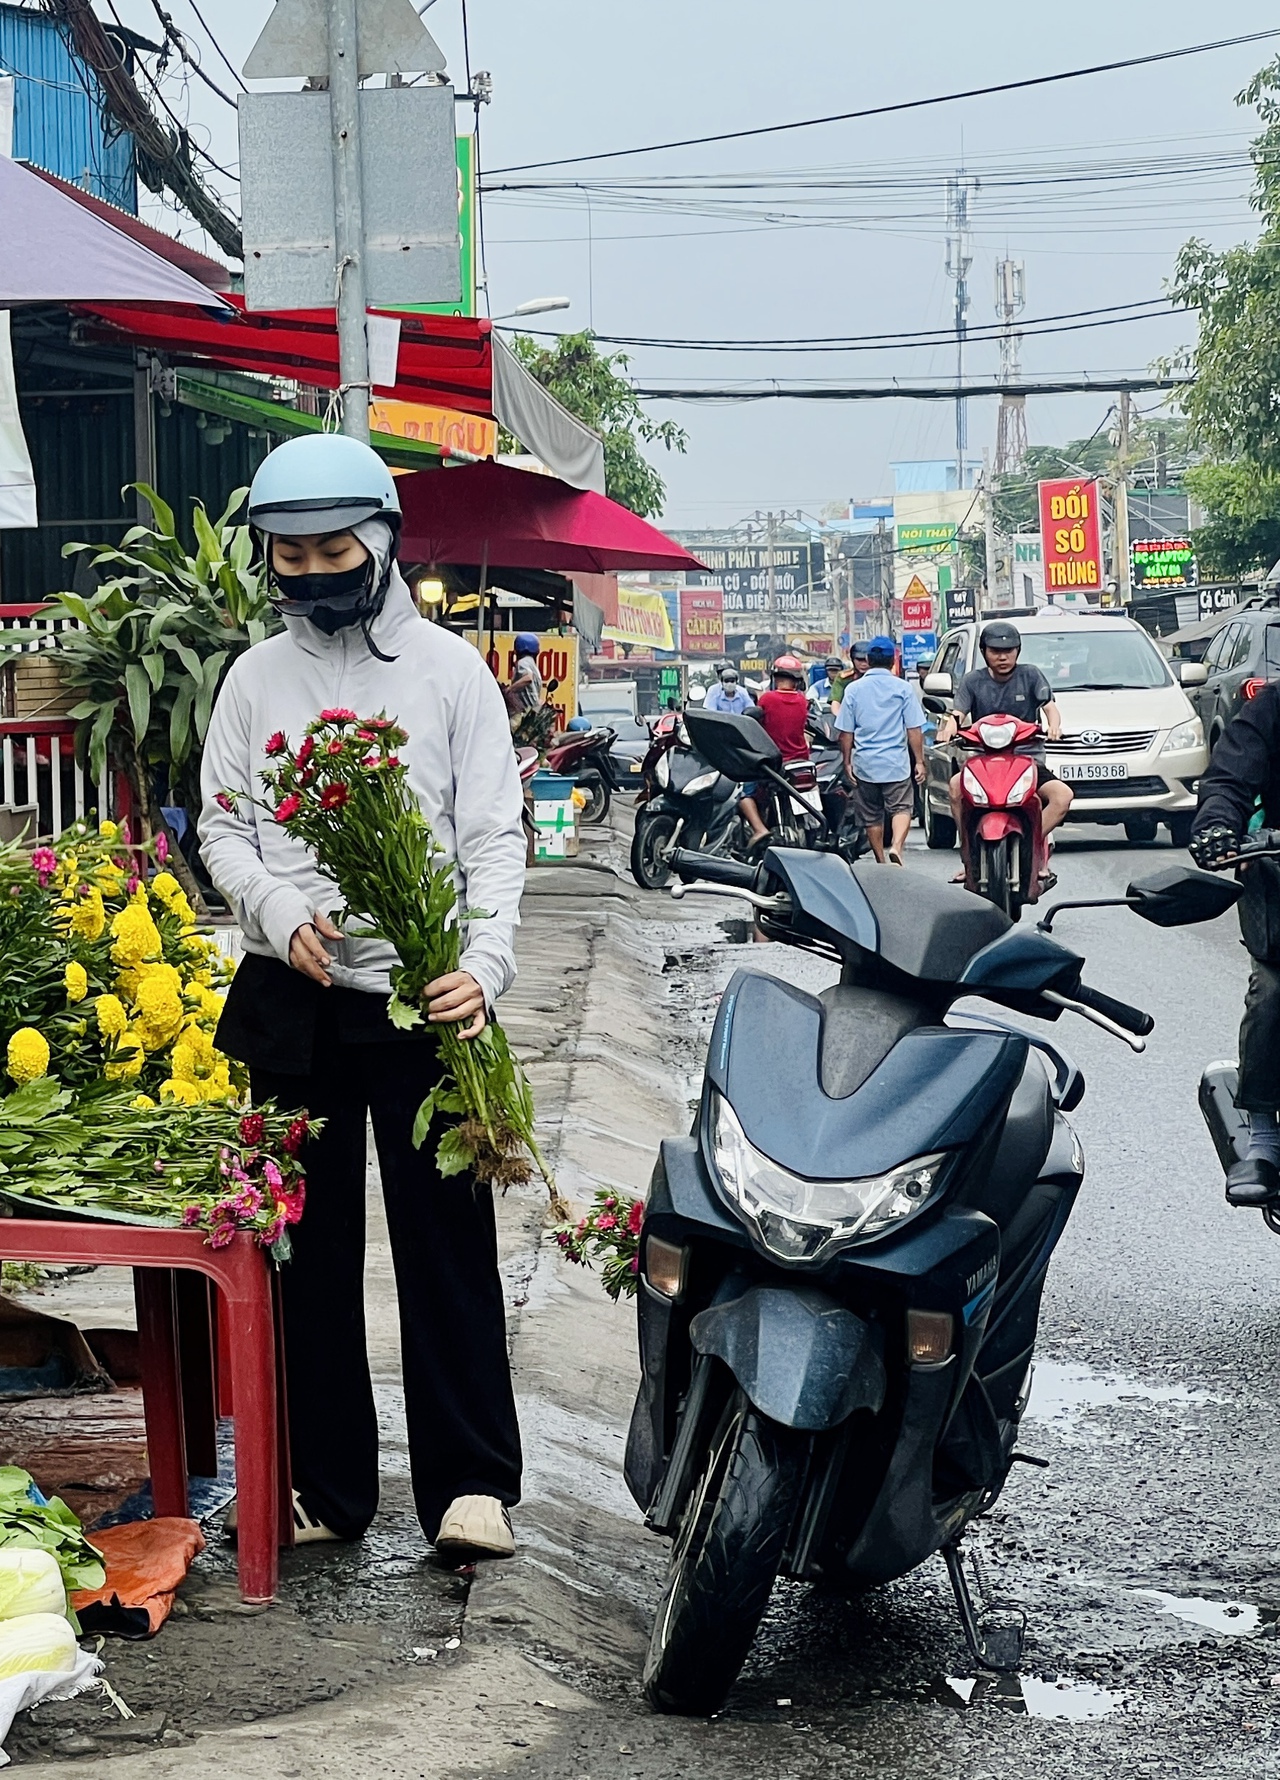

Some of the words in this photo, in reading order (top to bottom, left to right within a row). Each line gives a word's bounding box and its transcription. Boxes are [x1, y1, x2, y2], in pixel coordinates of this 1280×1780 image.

[1050, 486, 1089, 520] ĐỔI
[1055, 520, 1086, 554] SỐ
[728, 547, 756, 569] PHÁT
[759, 550, 800, 569] MBILE
[724, 573, 740, 591] CŨ
[1048, 556, 1098, 587] TRÚNG
[722, 592, 744, 610] HỮA
[1200, 590, 1213, 609] Cá
